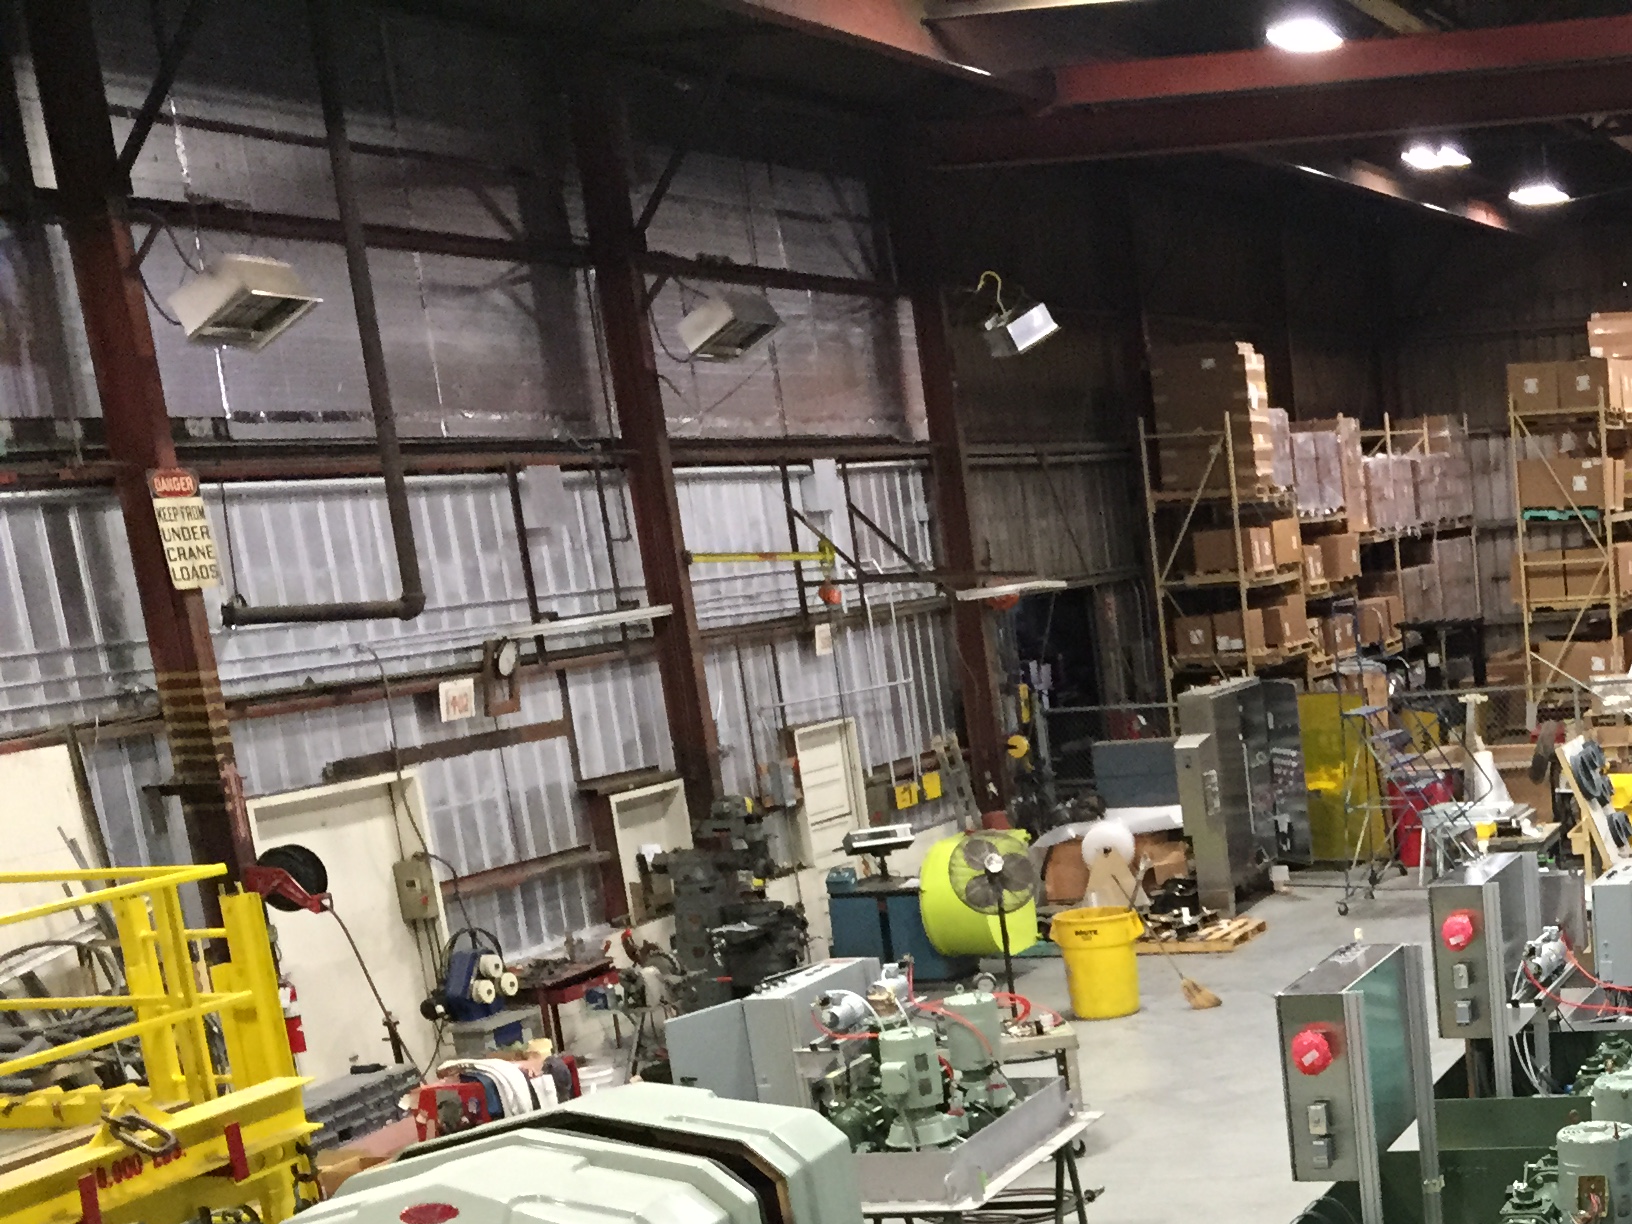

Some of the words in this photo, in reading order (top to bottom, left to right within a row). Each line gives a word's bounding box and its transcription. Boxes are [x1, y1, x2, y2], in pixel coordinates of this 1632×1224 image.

[153, 476, 195, 492] DANGER
[157, 506, 179, 522] KEEP
[180, 505, 206, 521] FROM
[161, 525, 210, 542] UNDER
[166, 544, 216, 562] CRANE
[171, 564, 219, 581] LOADS
